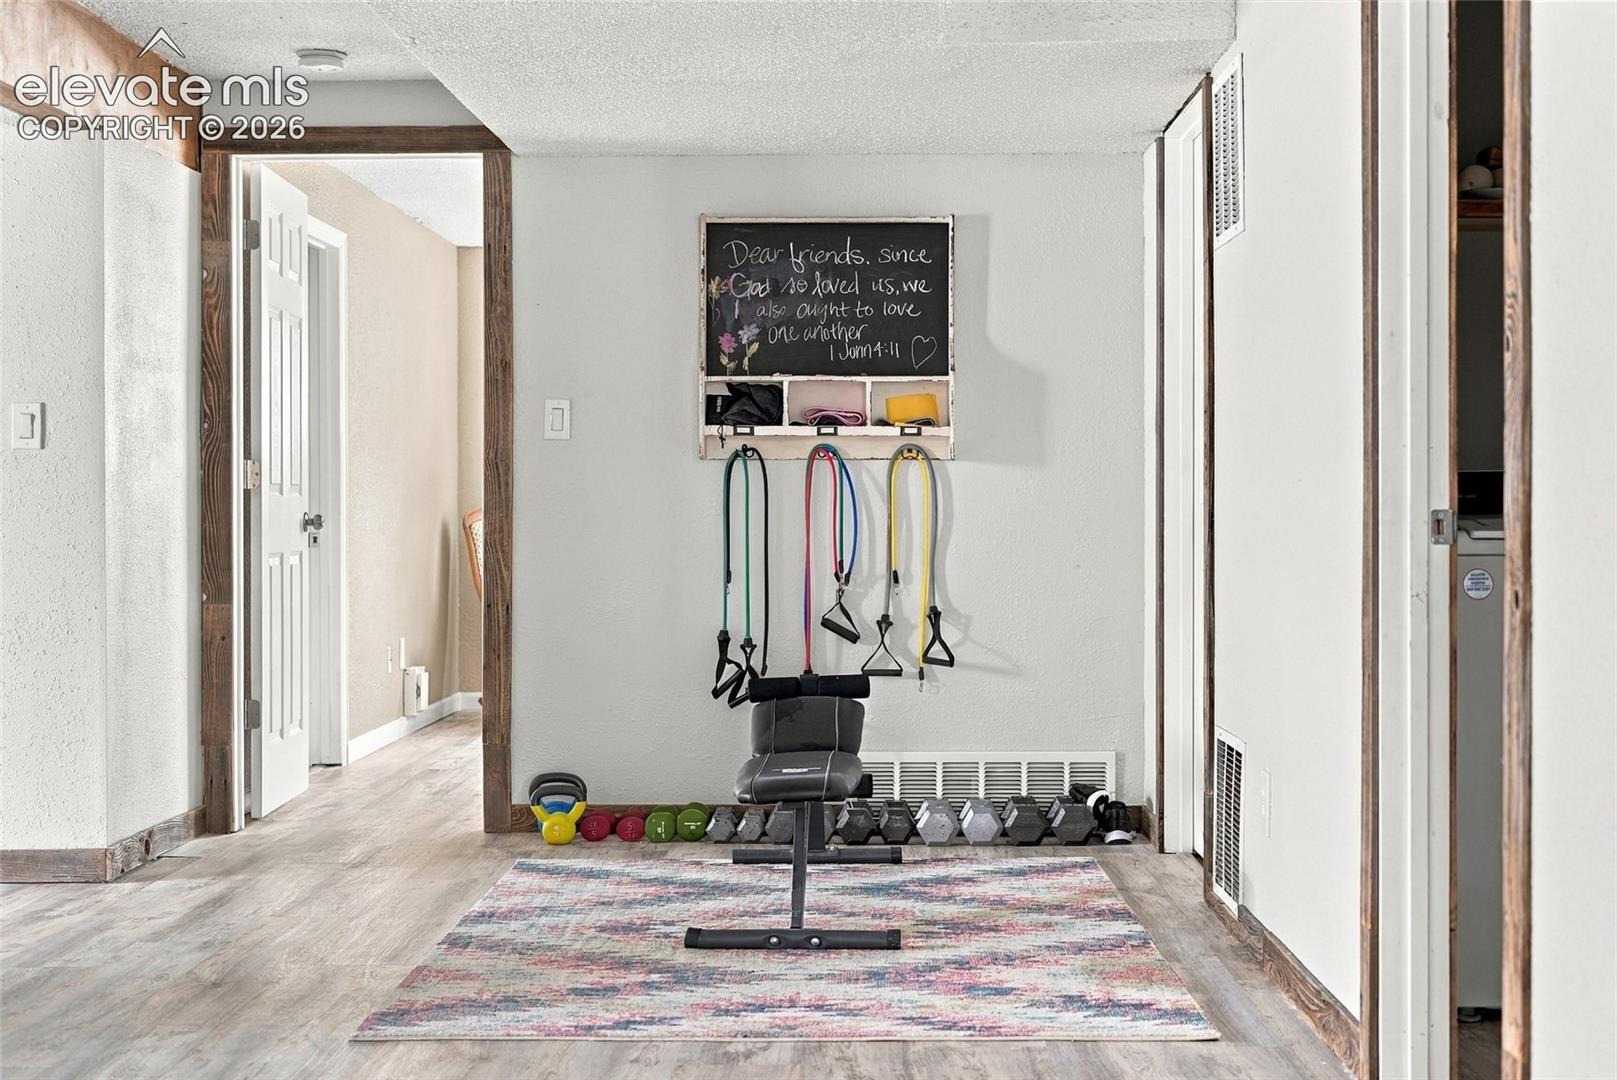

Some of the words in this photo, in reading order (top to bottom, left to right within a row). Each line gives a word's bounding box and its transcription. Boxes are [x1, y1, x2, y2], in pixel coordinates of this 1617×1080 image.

[722, 240, 785, 269] Dear
[878, 244, 933, 264] since
[729, 272, 772, 301] God
[780, 276, 808, 295] so
[811, 271, 860, 298] loved
[902, 279, 933, 293] we
[756, 300, 786, 319] also
[796, 301, 852, 325] ought
[853, 300, 874, 318] to
[883, 301, 922, 317] love
[768, 325, 800, 344] one
[803, 321, 869, 343] another
